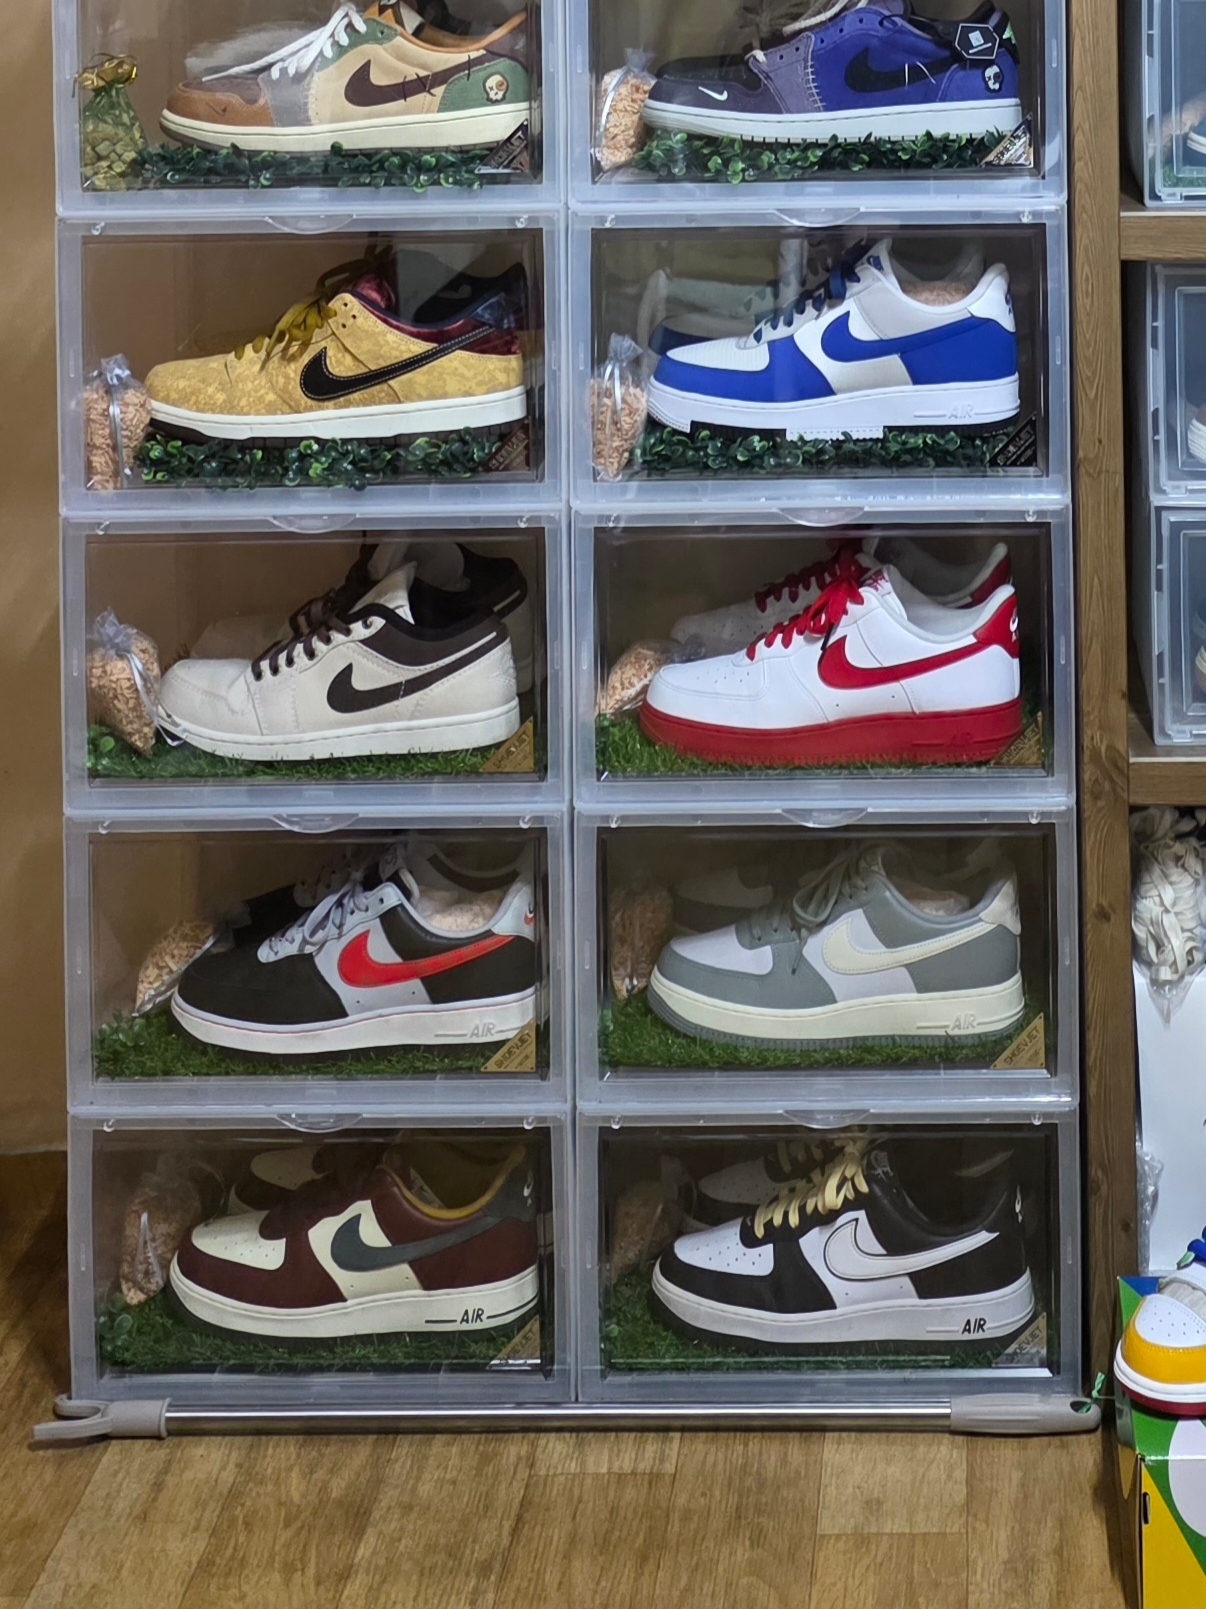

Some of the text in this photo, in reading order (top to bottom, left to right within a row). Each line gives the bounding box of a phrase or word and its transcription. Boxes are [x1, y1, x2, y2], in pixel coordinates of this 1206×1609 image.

[948, 404, 975, 420] AIR
[469, 1022, 496, 1039] AIR
[951, 1014, 978, 1031] AIR
[494, 1032, 532, 1069] SHOEVJET
[1003, 1026, 1040, 1065] SHOEVJET
[460, 1308, 485, 1325] AIR
[961, 1318, 987, 1335] AIR
